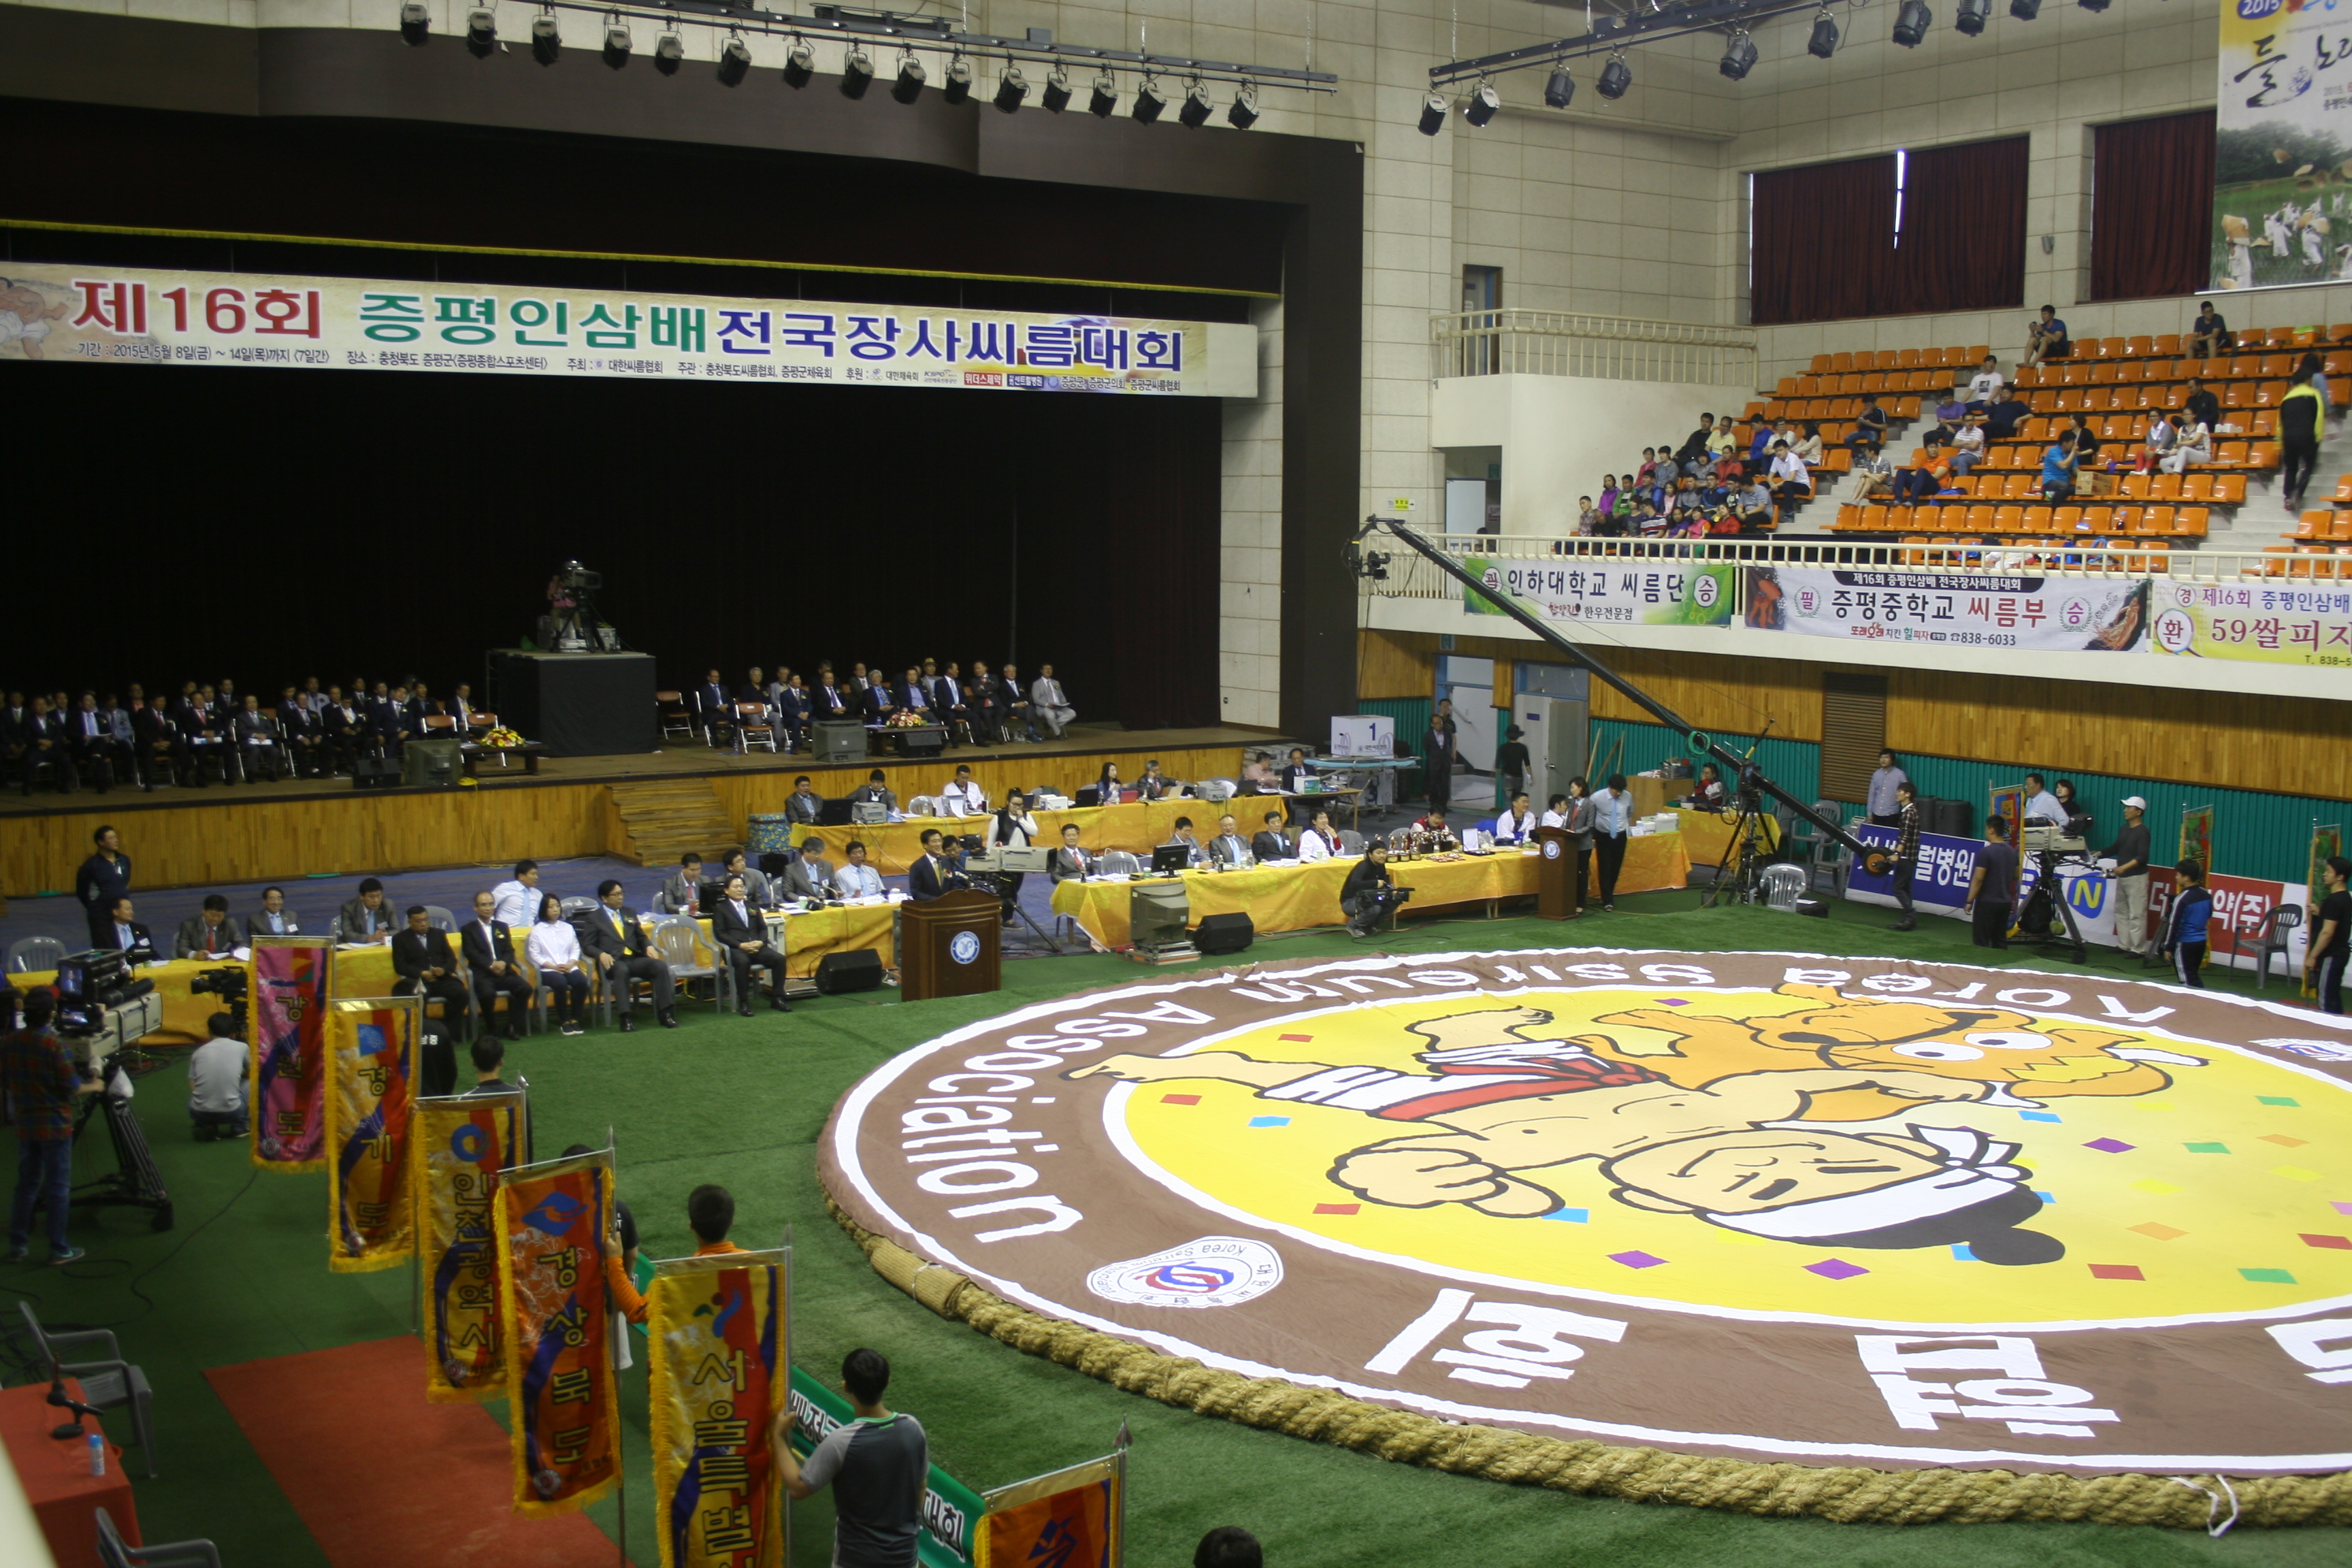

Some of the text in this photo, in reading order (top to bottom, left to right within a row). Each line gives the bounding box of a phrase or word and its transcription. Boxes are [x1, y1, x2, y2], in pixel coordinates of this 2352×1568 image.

[72, 281, 1183, 372] 제16회 증평인삼배 전국장사씨름대회
[114, 344, 150, 359] 2015년
[154, 344, 172, 359] 5월
[176, 346, 211, 361] 8일(금)
[230, 348, 289, 363] 14일(목)까지
[379, 351, 419, 366] 충청북도
[608, 360, 663, 374] 대한씨름협회
[781, 365, 832, 379] 증평군체육회
[885, 371, 918, 382] 대한체육회
[966, 373, 1001, 385] 위더스제약
[1130, 379, 1180, 391] 증평군씨름협회
[1507, 570, 1606, 600] 인하대학교
[1621, 573, 1684, 602] 씨름단
[1699, 579, 1714, 602] 승
[1853, 572, 2021, 591] 제16회 증평인삼배 전국장사씨름대회
[1800, 591, 1814, 610] 필
[1831, 590, 1955, 622] 증평중학교
[1967, 596, 2046, 629] 씨름부
[2065, 602, 2085, 623] 승
[2179, 588, 2349, 613] 경 제16회 증평인삼배
[1584, 606, 1633, 621] 한우전문점
[1885, 628, 1901, 639] 치킨
[1961, 632, 2016, 646] 838-6033
[2163, 619, 2183, 645] 환
[1369, 723, 1375, 741] 1
[2073, 879, 2102, 909] N
[357, 1065, 392, 1228] 경기도
[1203, 1243, 1247, 1257] Korea
